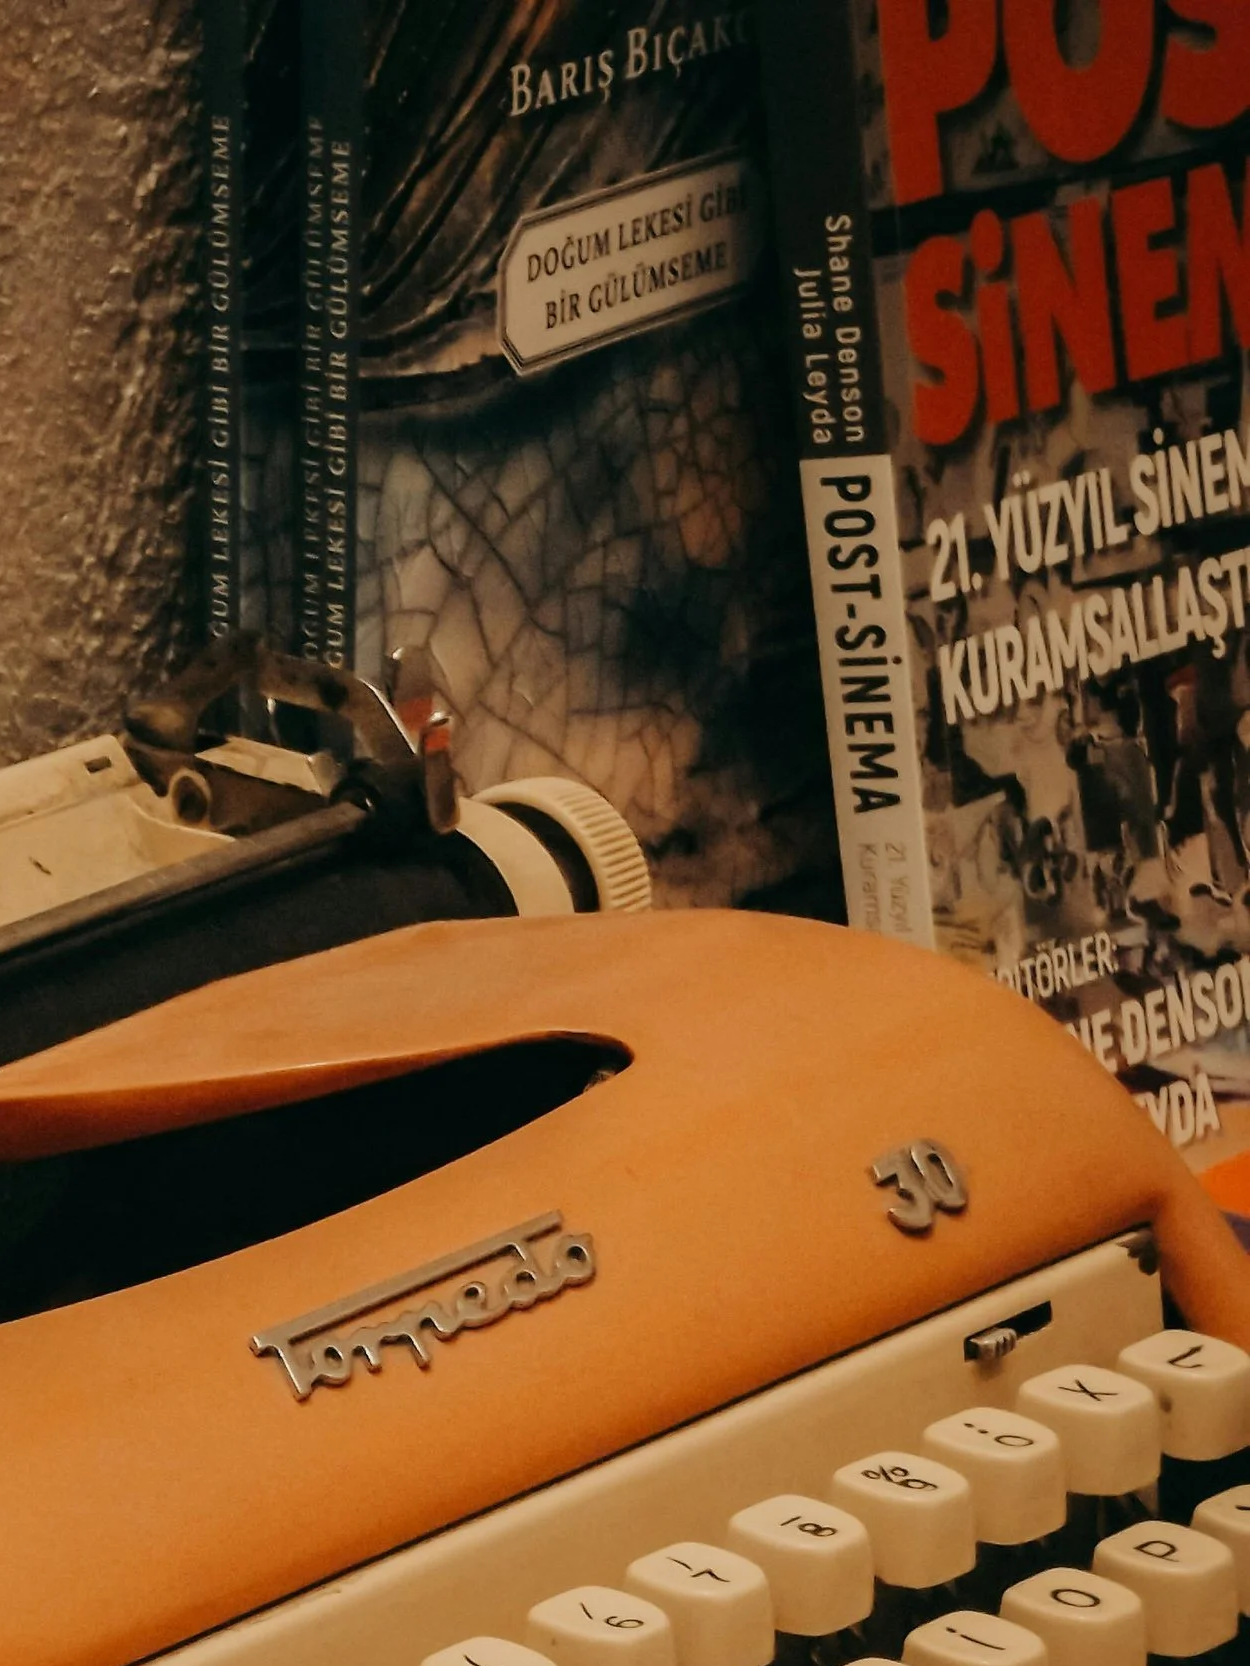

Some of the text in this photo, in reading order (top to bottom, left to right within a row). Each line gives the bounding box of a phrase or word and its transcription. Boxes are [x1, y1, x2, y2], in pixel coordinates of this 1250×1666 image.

[509, 50, 614, 117] BARIŞ
[526, 229, 611, 283] DOĞUM
[618, 193, 693, 252] LEKESİ
[545, 242, 729, 330] BİR GÜLÜMSEME
[793, 268, 837, 444] Julia Leyda
[825, 214, 865, 442] Shane Denson
[927, 512, 982, 603] 21.
[983, 467, 1128, 582] YÜZYIL
[939, 547, 1250, 725] KURAMSALLAŞT
[872, 1138, 968, 1237] 30
[249, 1209, 596, 1403] Torpedo
